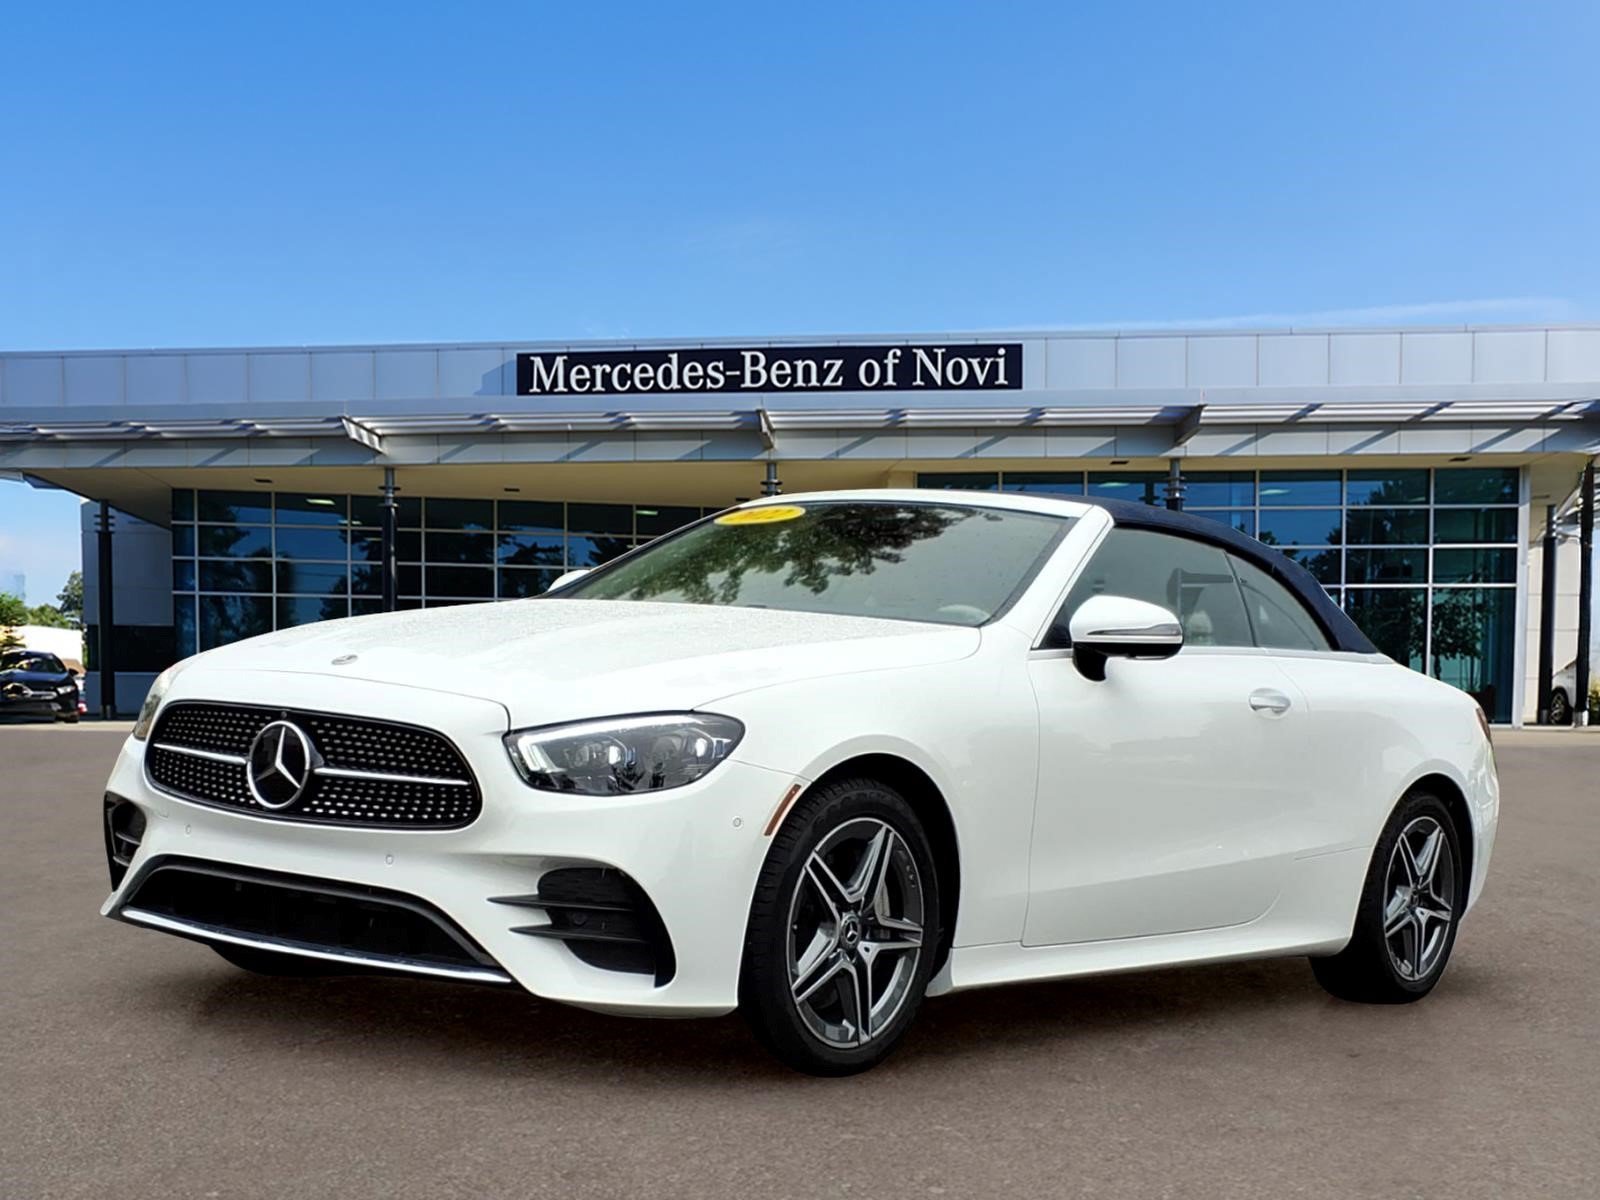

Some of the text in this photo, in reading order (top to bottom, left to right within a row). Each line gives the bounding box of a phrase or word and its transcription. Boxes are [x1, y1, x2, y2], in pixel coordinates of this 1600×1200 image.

[529, 347, 1009, 393] Mercedes-Benz of Novi
